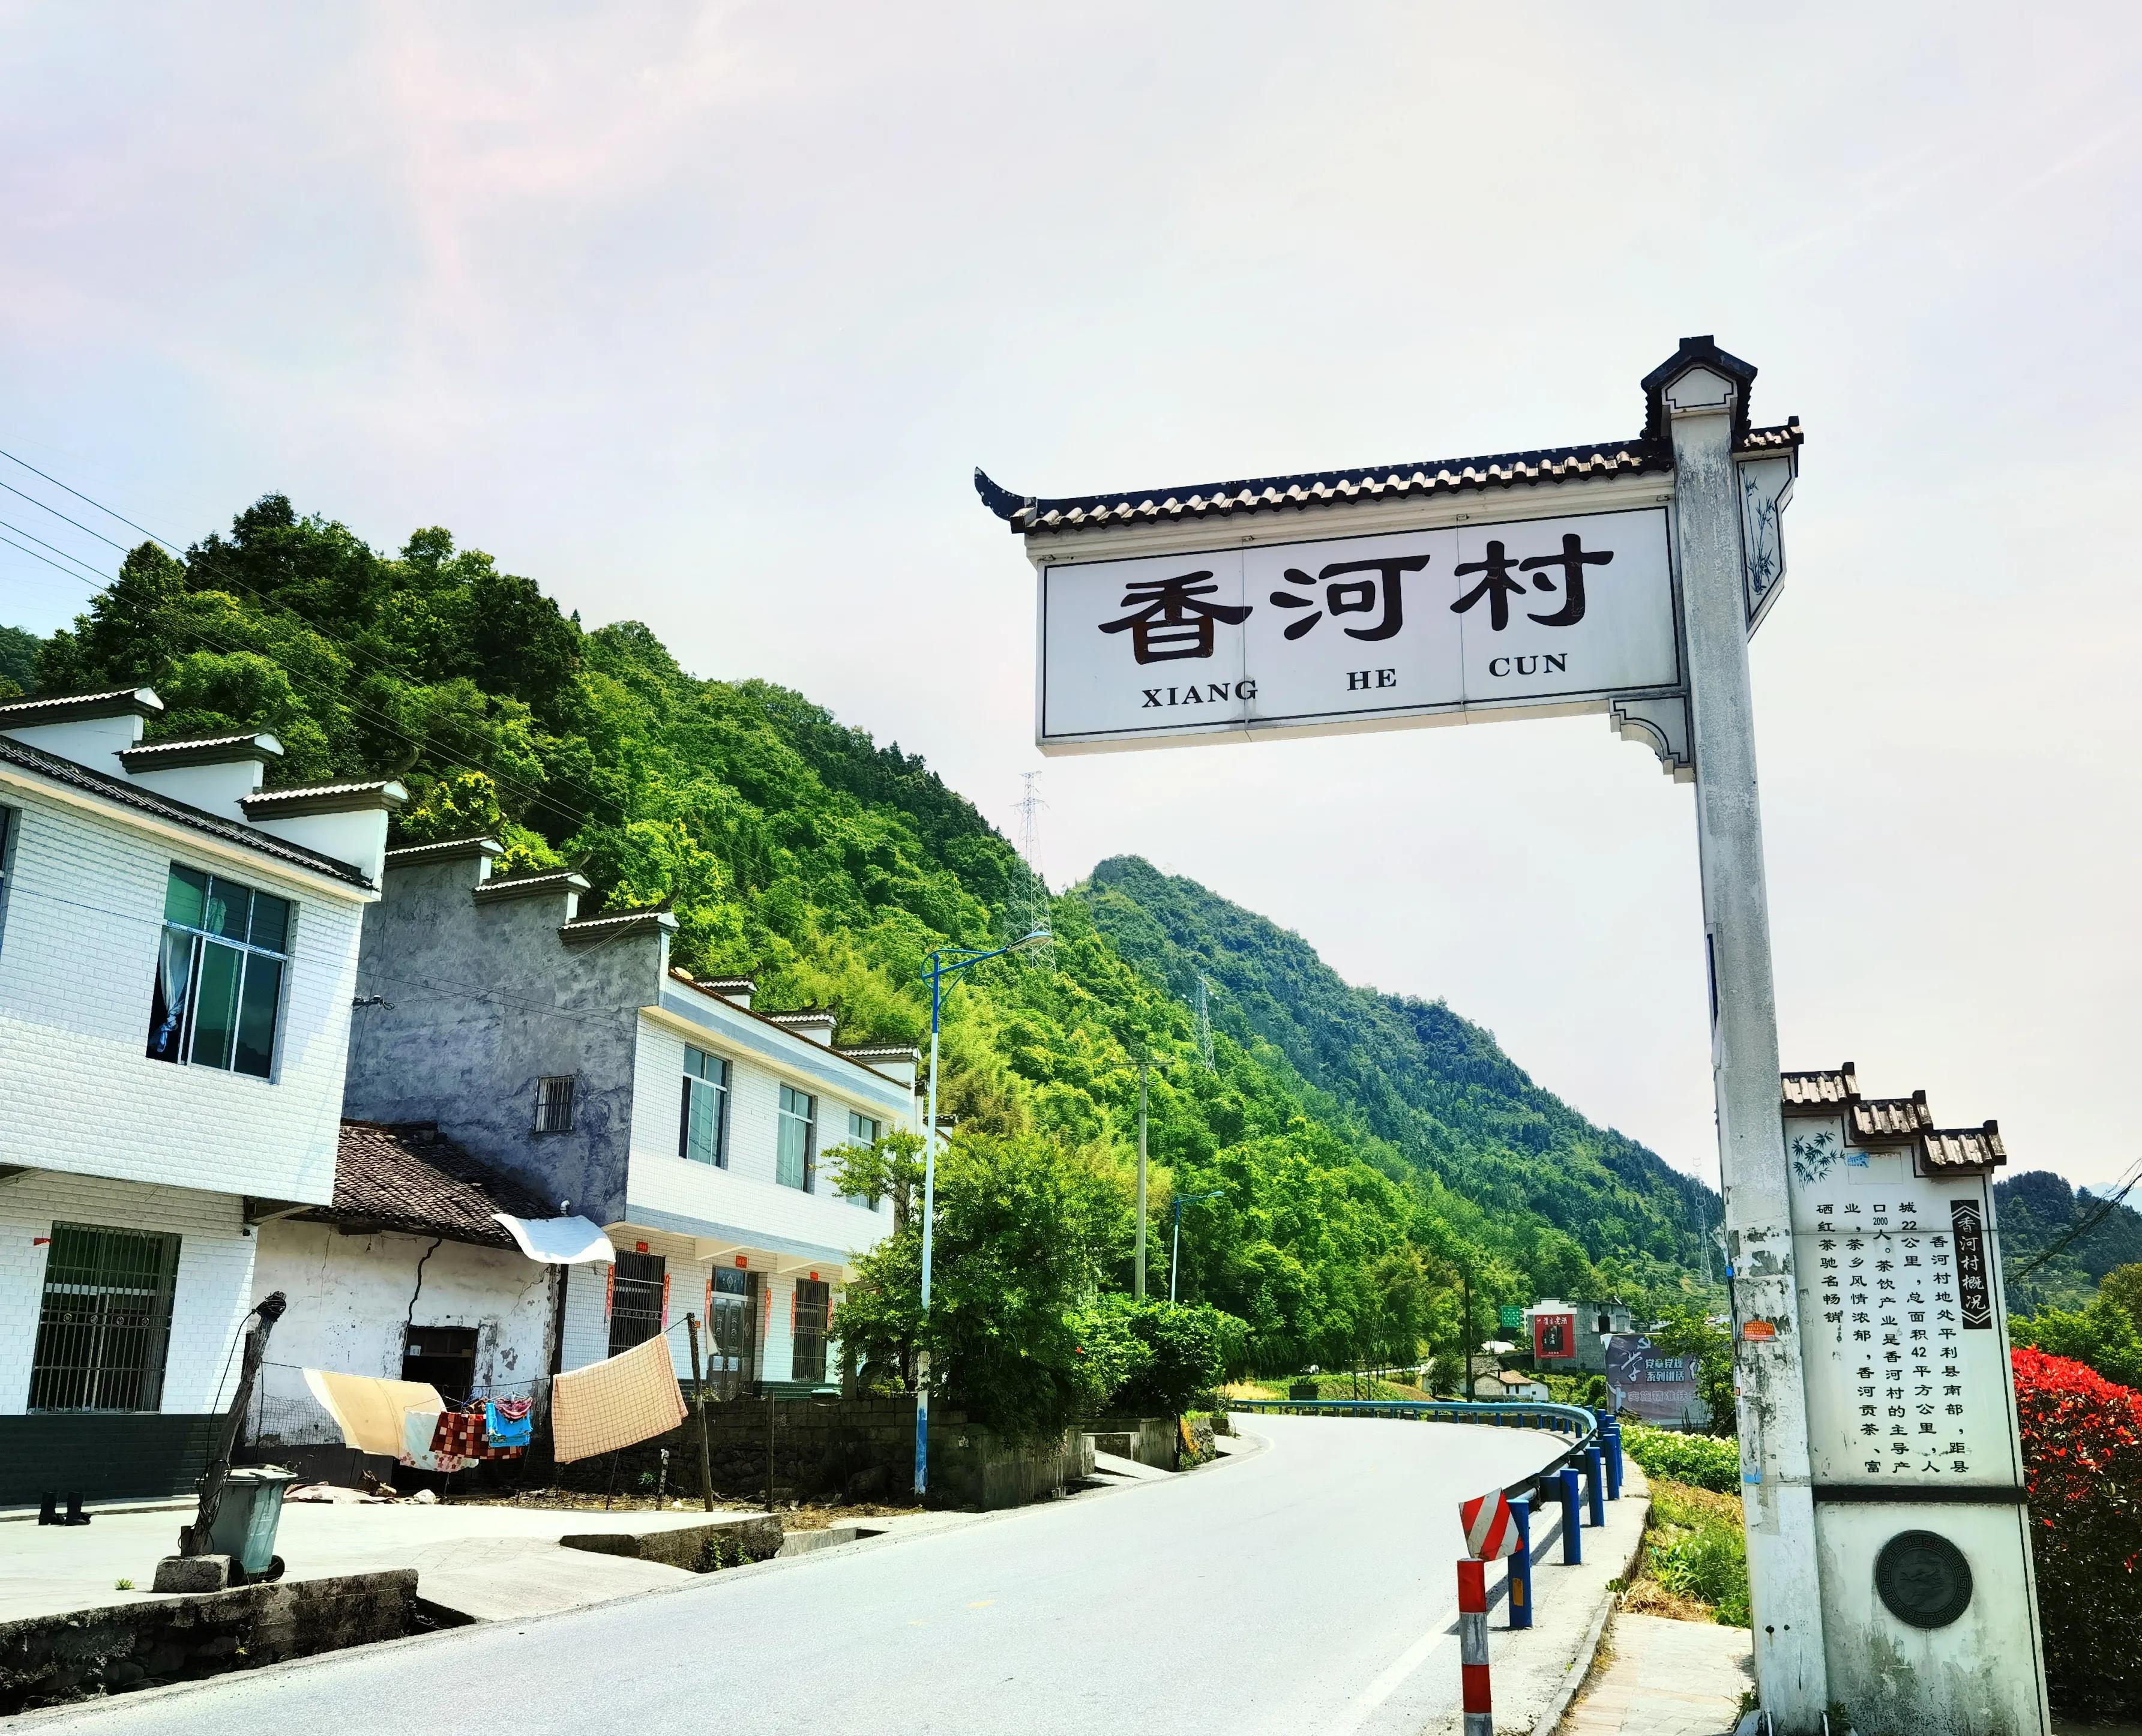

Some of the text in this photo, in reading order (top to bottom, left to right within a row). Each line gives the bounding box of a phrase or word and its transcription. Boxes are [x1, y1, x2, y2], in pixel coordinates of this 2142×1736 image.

[1098, 533, 1613, 664] 香河村
[1142, 652, 1568, 708] XIANG HE CUN
[1958, 1216, 1986, 1309] 香河村概况
[1646, 1371, 1685, 1382] 系列讲话
[1930, 1236, 1969, 1473] 香河村地处平利县南部，距县
